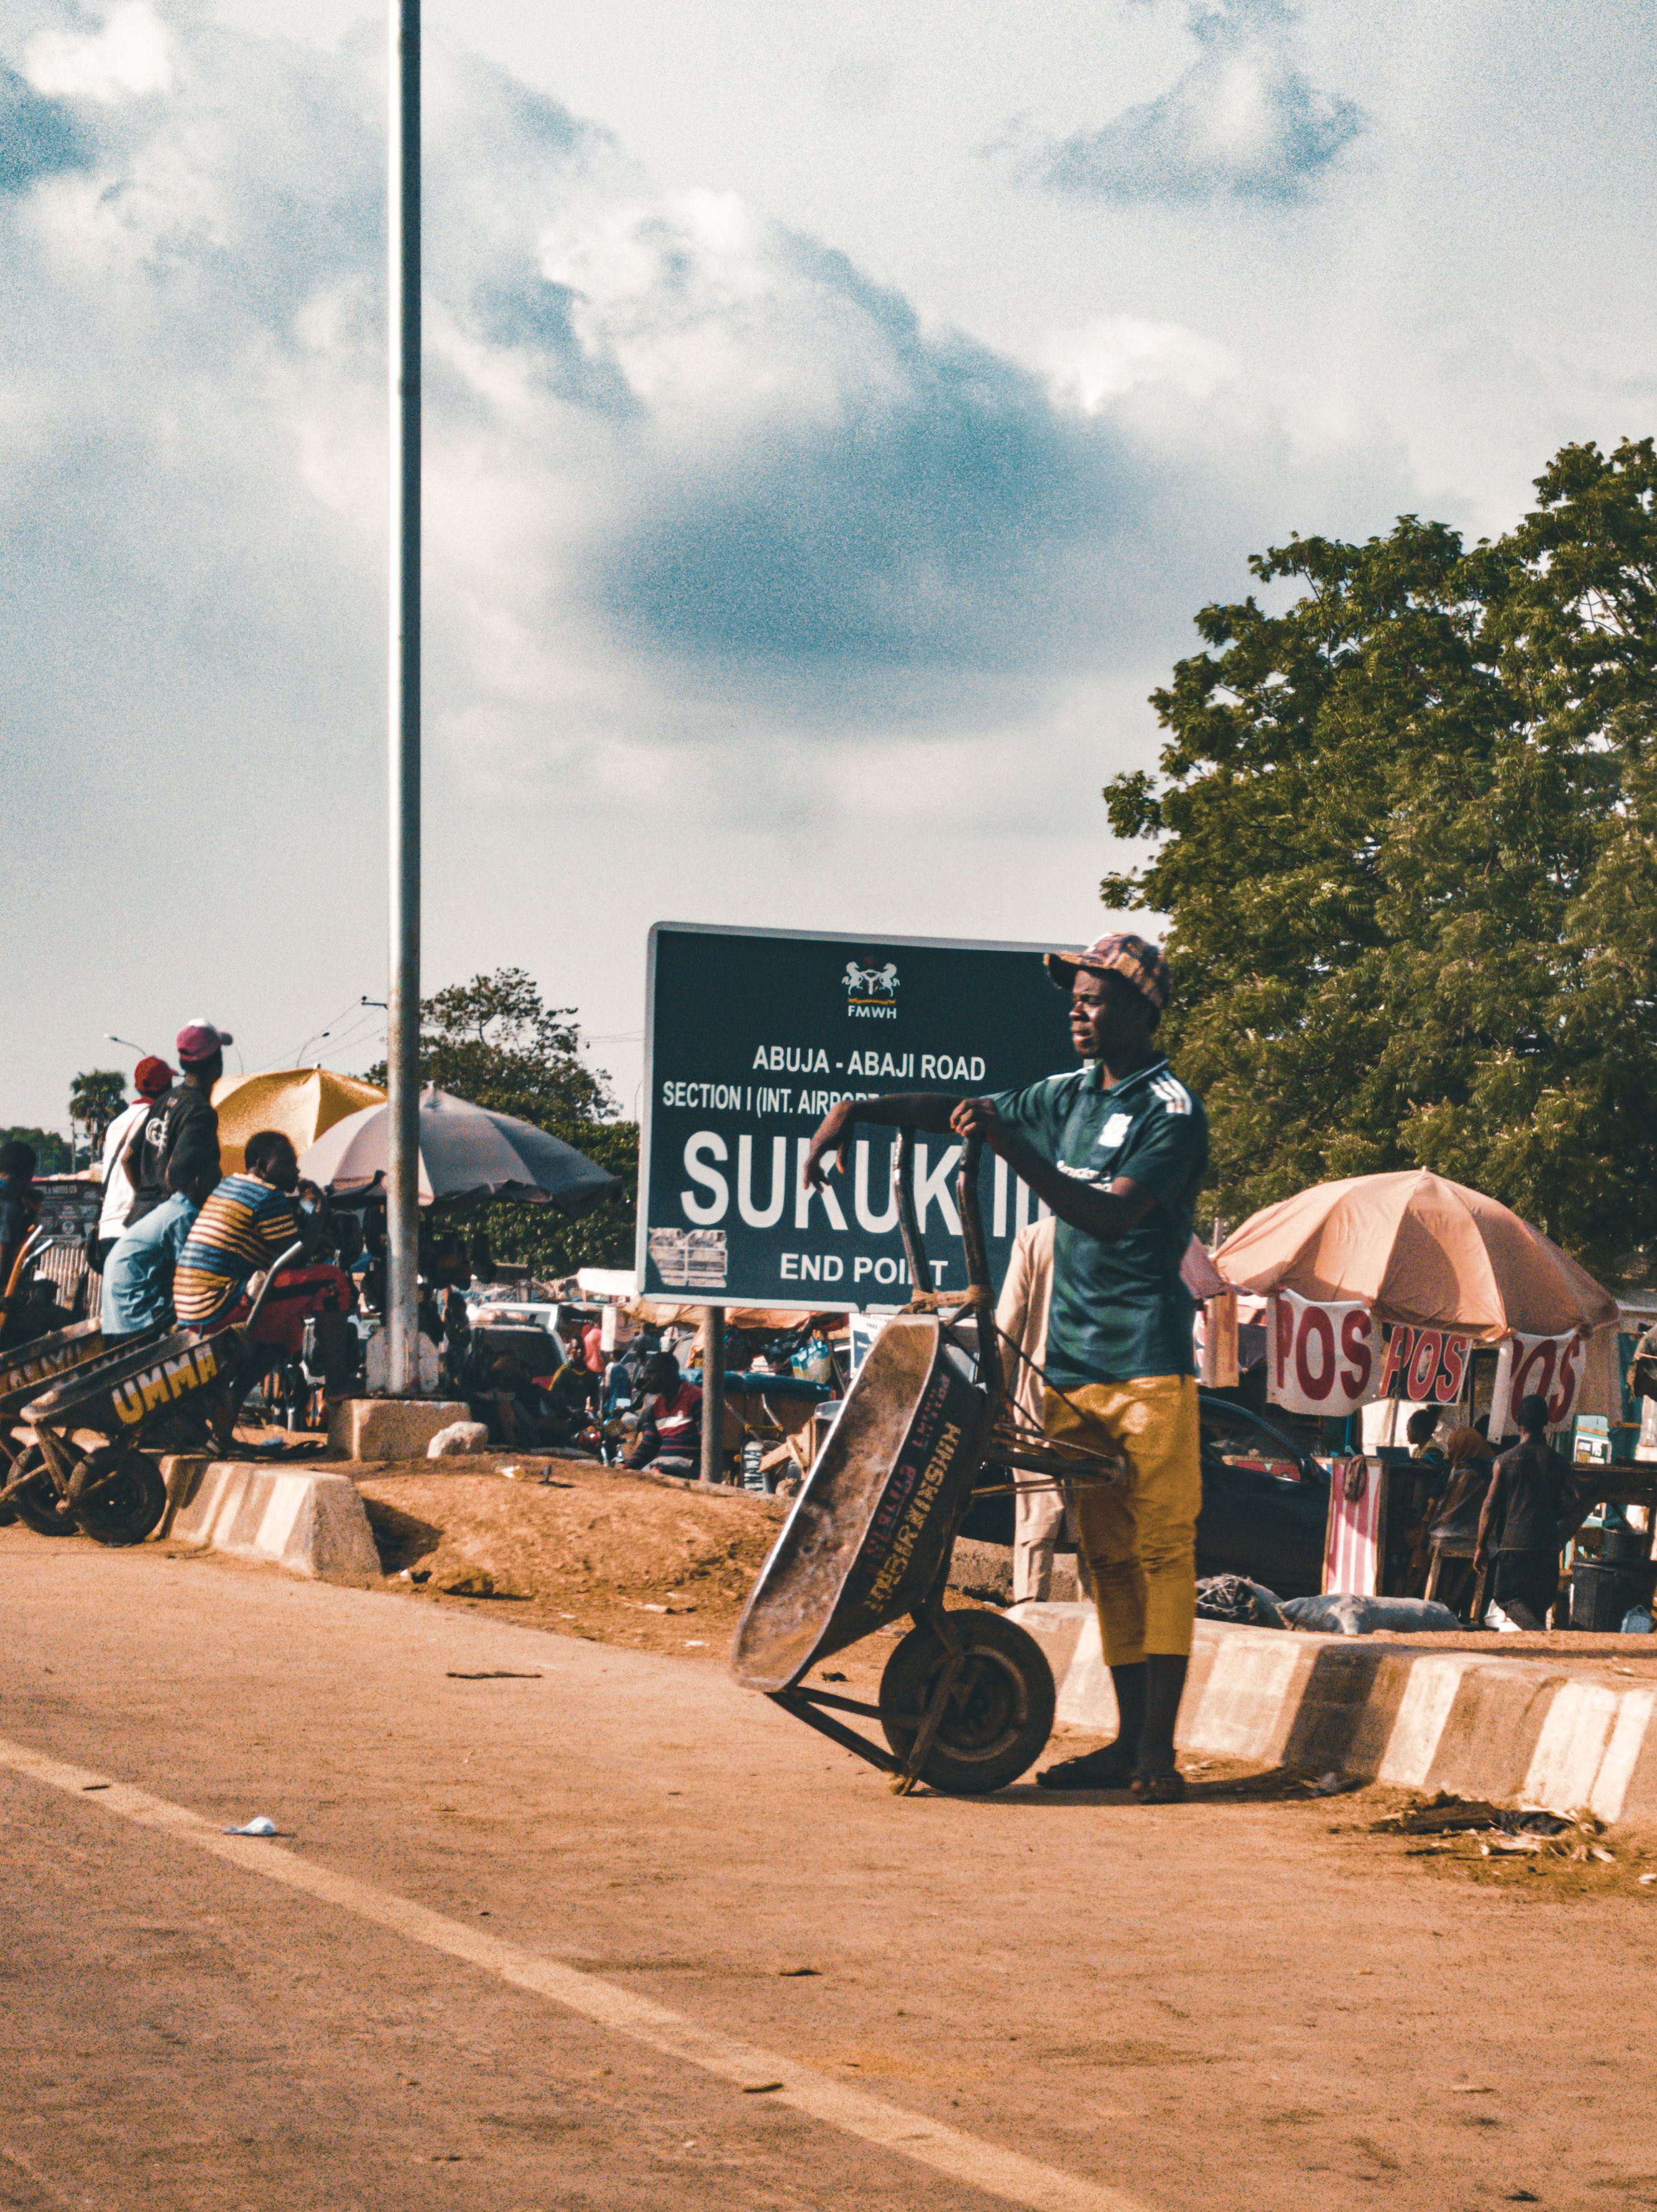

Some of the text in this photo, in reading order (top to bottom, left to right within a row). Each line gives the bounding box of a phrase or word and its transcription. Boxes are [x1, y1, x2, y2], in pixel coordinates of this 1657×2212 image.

[847, 1005, 897, 1020] FMWH
[752, 1044, 830, 1074] ABUJA
[847, 1050, 914, 1078] ABAJI
[921, 1054, 986, 1081] ROAD
[662, 1081, 742, 1111] SECTION
[746, 1086, 752, 1112] I
[756, 1087, 794, 1118] (INT.
[680, 1130, 965, 1236] SUKUK
[780, 1252, 949, 1286] END POIT
[1275, 1296, 1372, 1401] POS
[1380, 1326, 1469, 1403] POS
